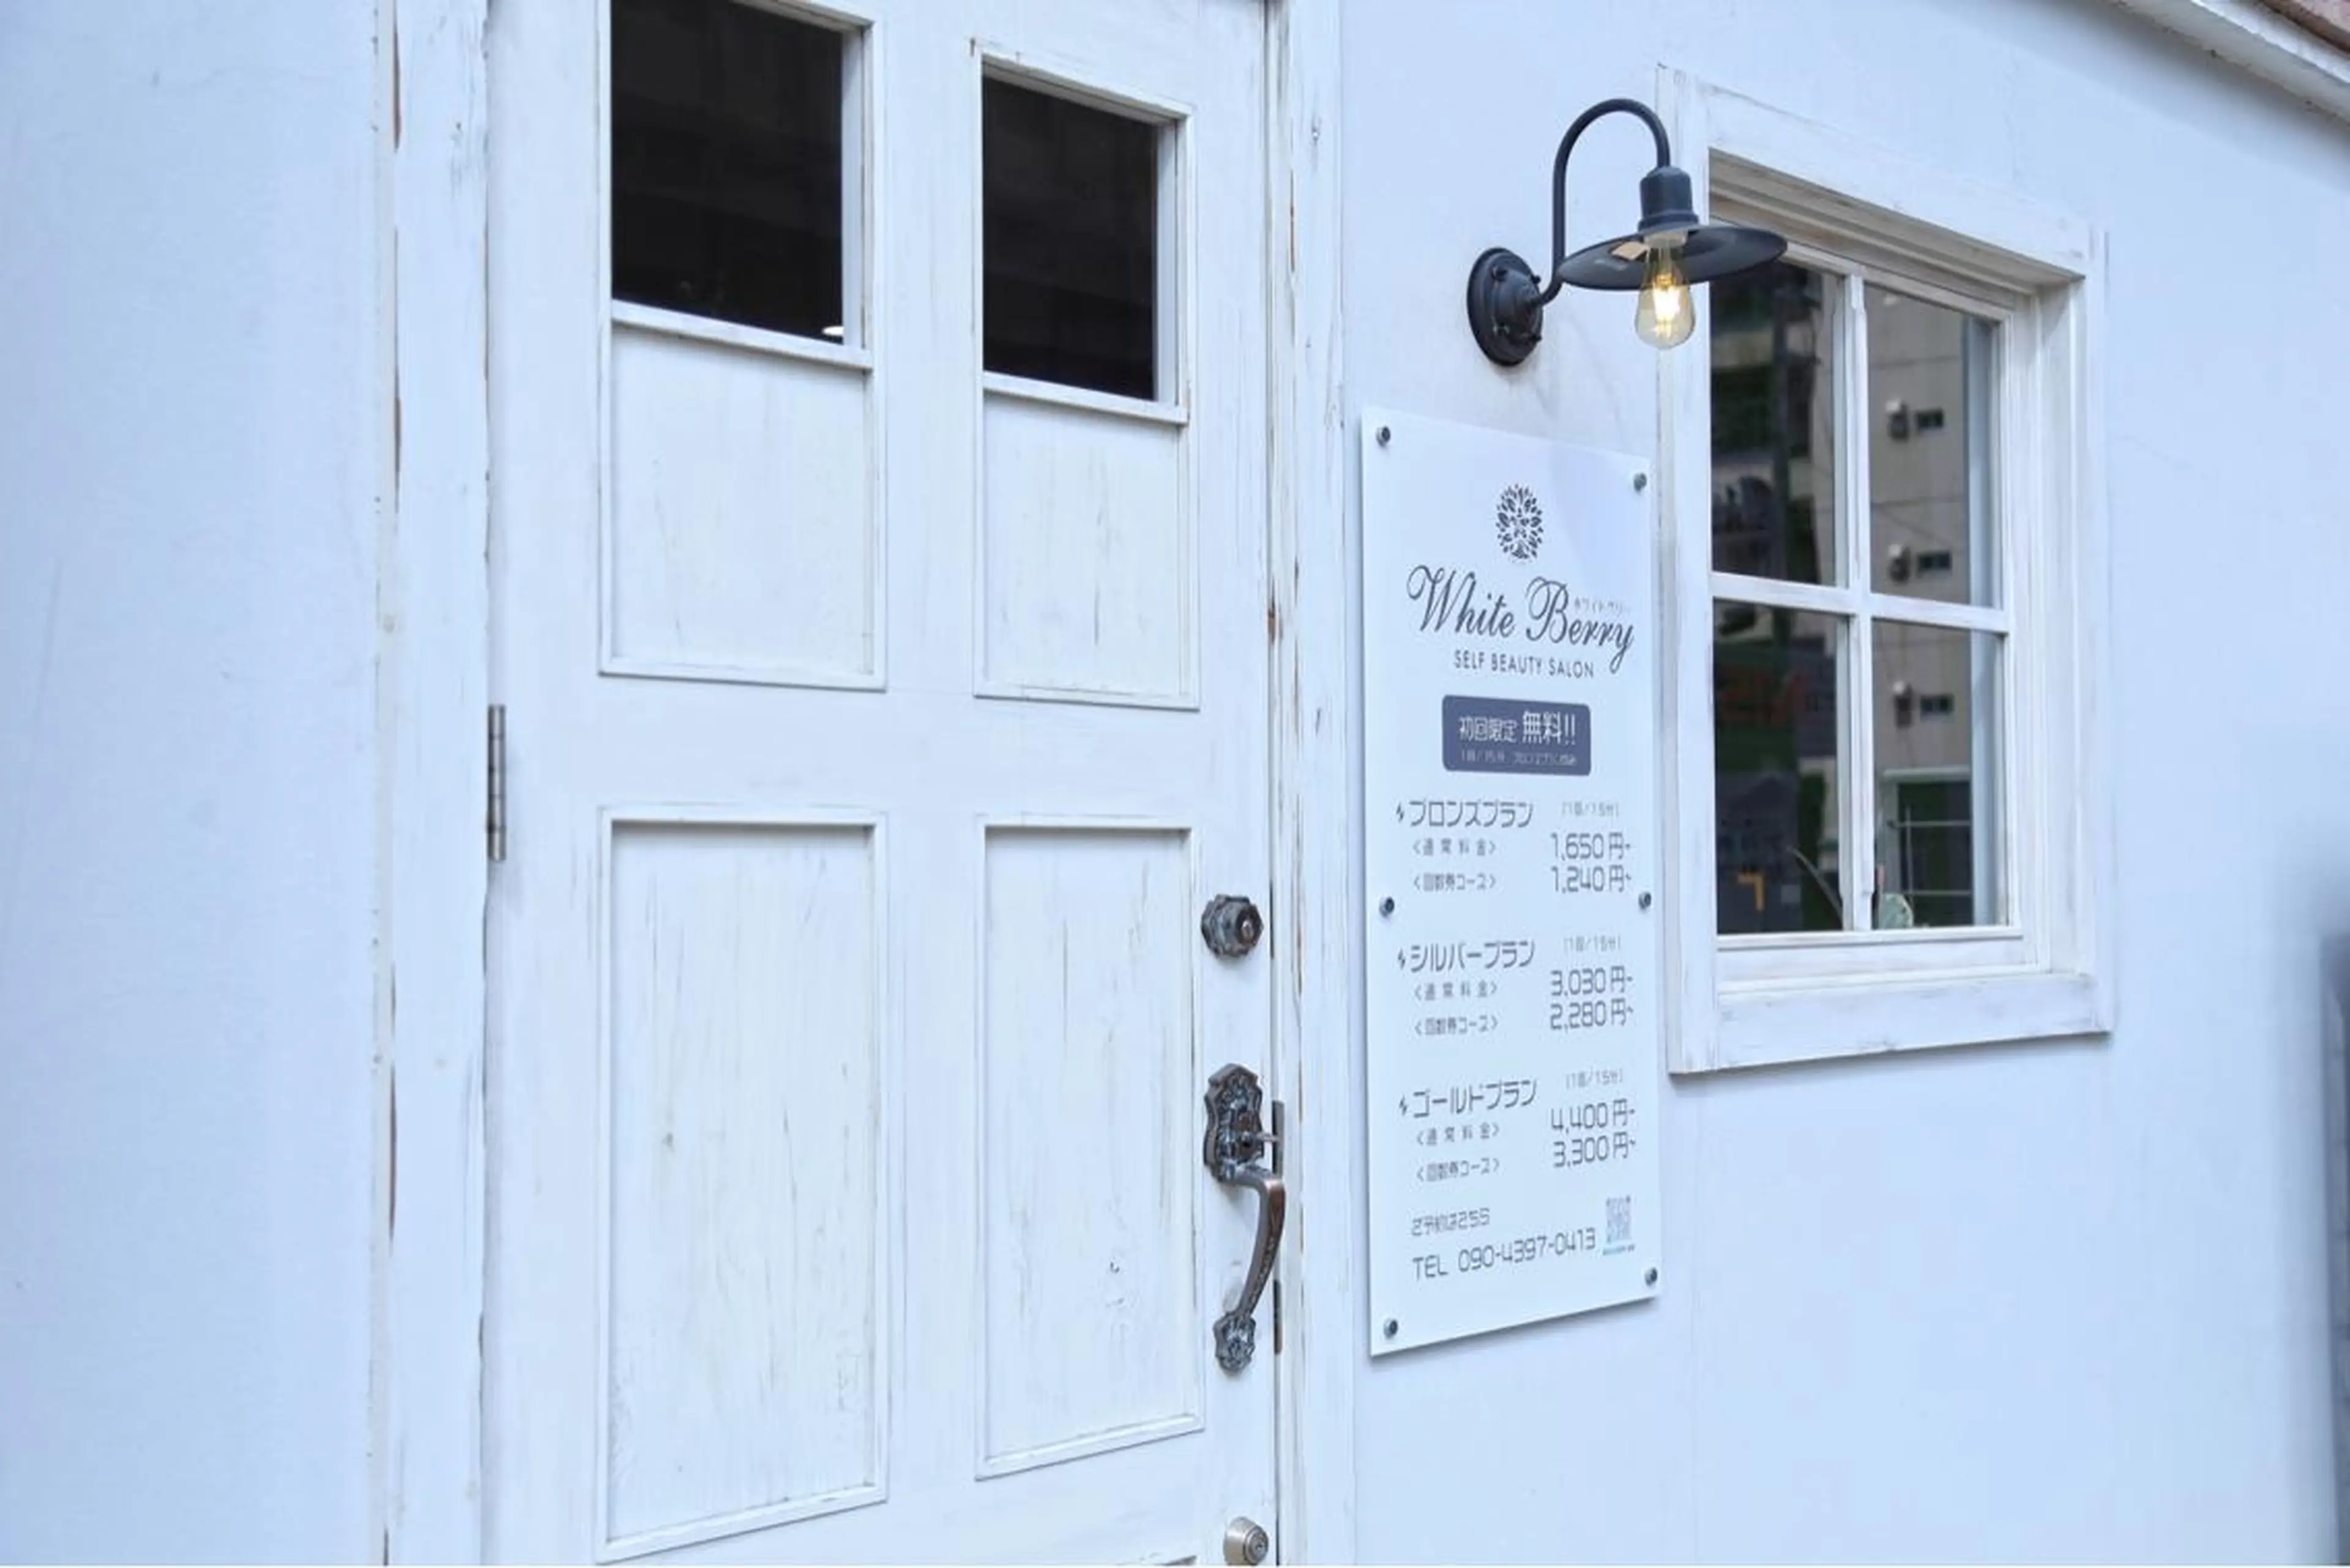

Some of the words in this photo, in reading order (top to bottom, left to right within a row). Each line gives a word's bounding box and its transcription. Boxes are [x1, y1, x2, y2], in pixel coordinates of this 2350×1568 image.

[1406, 565, 1515, 638] White
[1526, 576, 1633, 674] Berry
[1454, 649, 1485, 669] SELF
[1491, 653, 1542, 674] BEAUTY
[1549, 659, 1594, 678] SALON
[1411, 939, 1535, 973] シルバープラン
[1413, 1079, 1537, 1118] ゴールドプラン
[1412, 1255, 1449, 1279] TEL
[1458, 1227, 1595, 1272] 090-4397-0413
